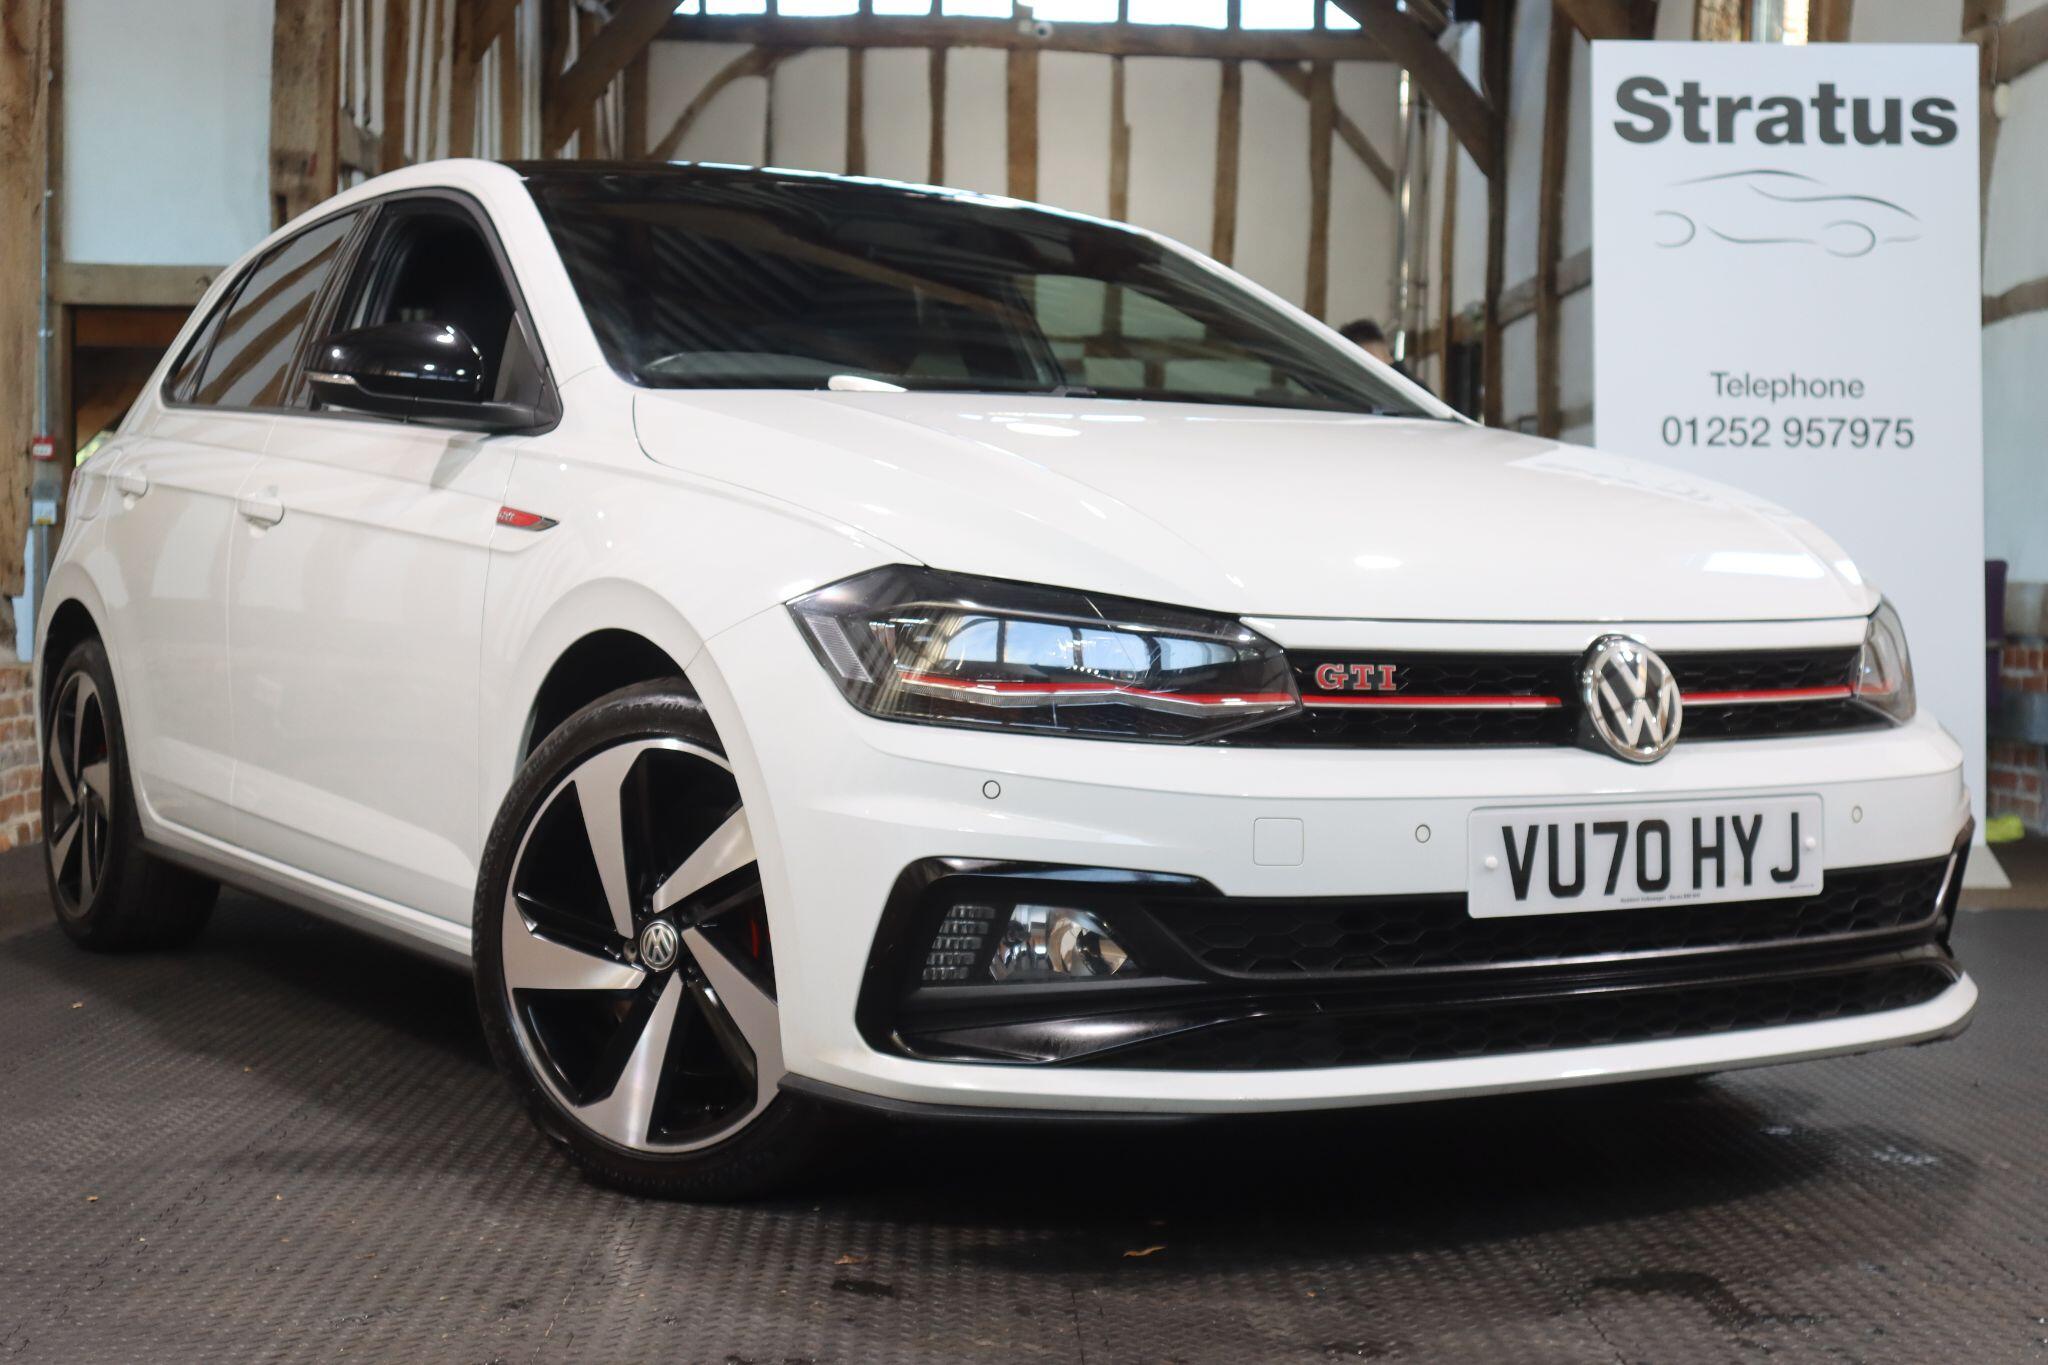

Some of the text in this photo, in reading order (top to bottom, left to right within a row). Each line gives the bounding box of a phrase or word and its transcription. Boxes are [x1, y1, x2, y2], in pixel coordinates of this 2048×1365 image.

[1613, 76, 1958, 147] Stratus
[1710, 372, 1865, 403] Telephone
[1662, 416, 1915, 449] 01252 957975
[1315, 663, 1397, 691] GTI
[1502, 811, 1800, 901] VU70 HYJ
